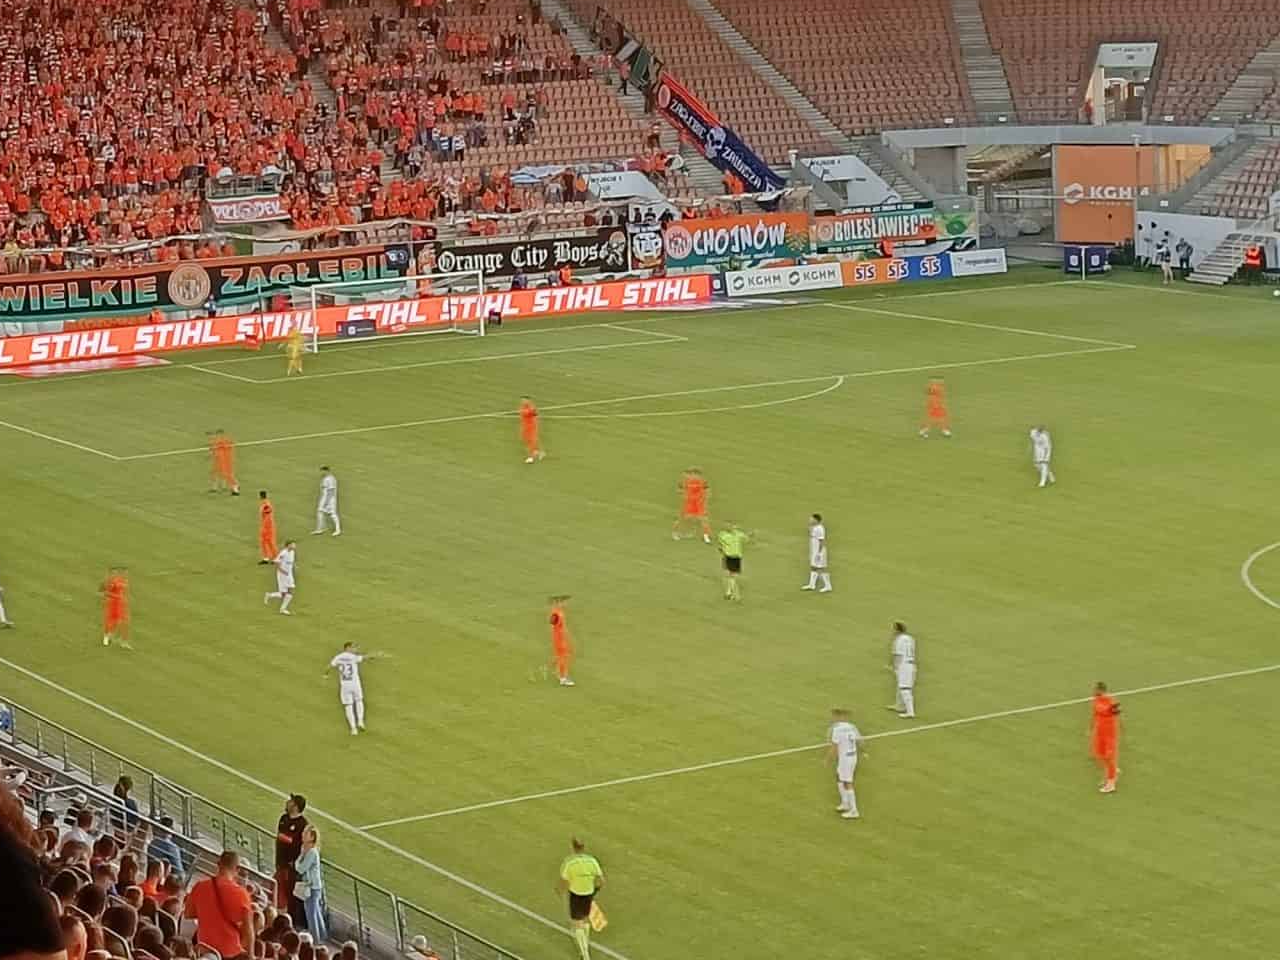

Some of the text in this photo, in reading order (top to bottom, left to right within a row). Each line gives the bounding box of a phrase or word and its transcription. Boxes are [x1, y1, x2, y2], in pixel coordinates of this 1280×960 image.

[693, 218, 787, 255] CHOJNÓW
[834, 214, 920, 241] BOLESŁAWIEC
[438, 241, 597, 273] Orange City Boys
[855, 263, 875, 281] STS
[888, 260, 908, 279] STS
[921, 257, 941, 276] STS
[747, 269, 837, 286] KGHM KGHM
[29, 331, 120, 361] STIHL
[134, 319, 221, 350] STIHL
[235, 311, 320, 340] STIHL
[347, 302, 427, 327] STIHL
[440, 292, 520, 320] STIHL
[533, 286, 609, 312] STIHL
[623, 278, 698, 303] STIHL
